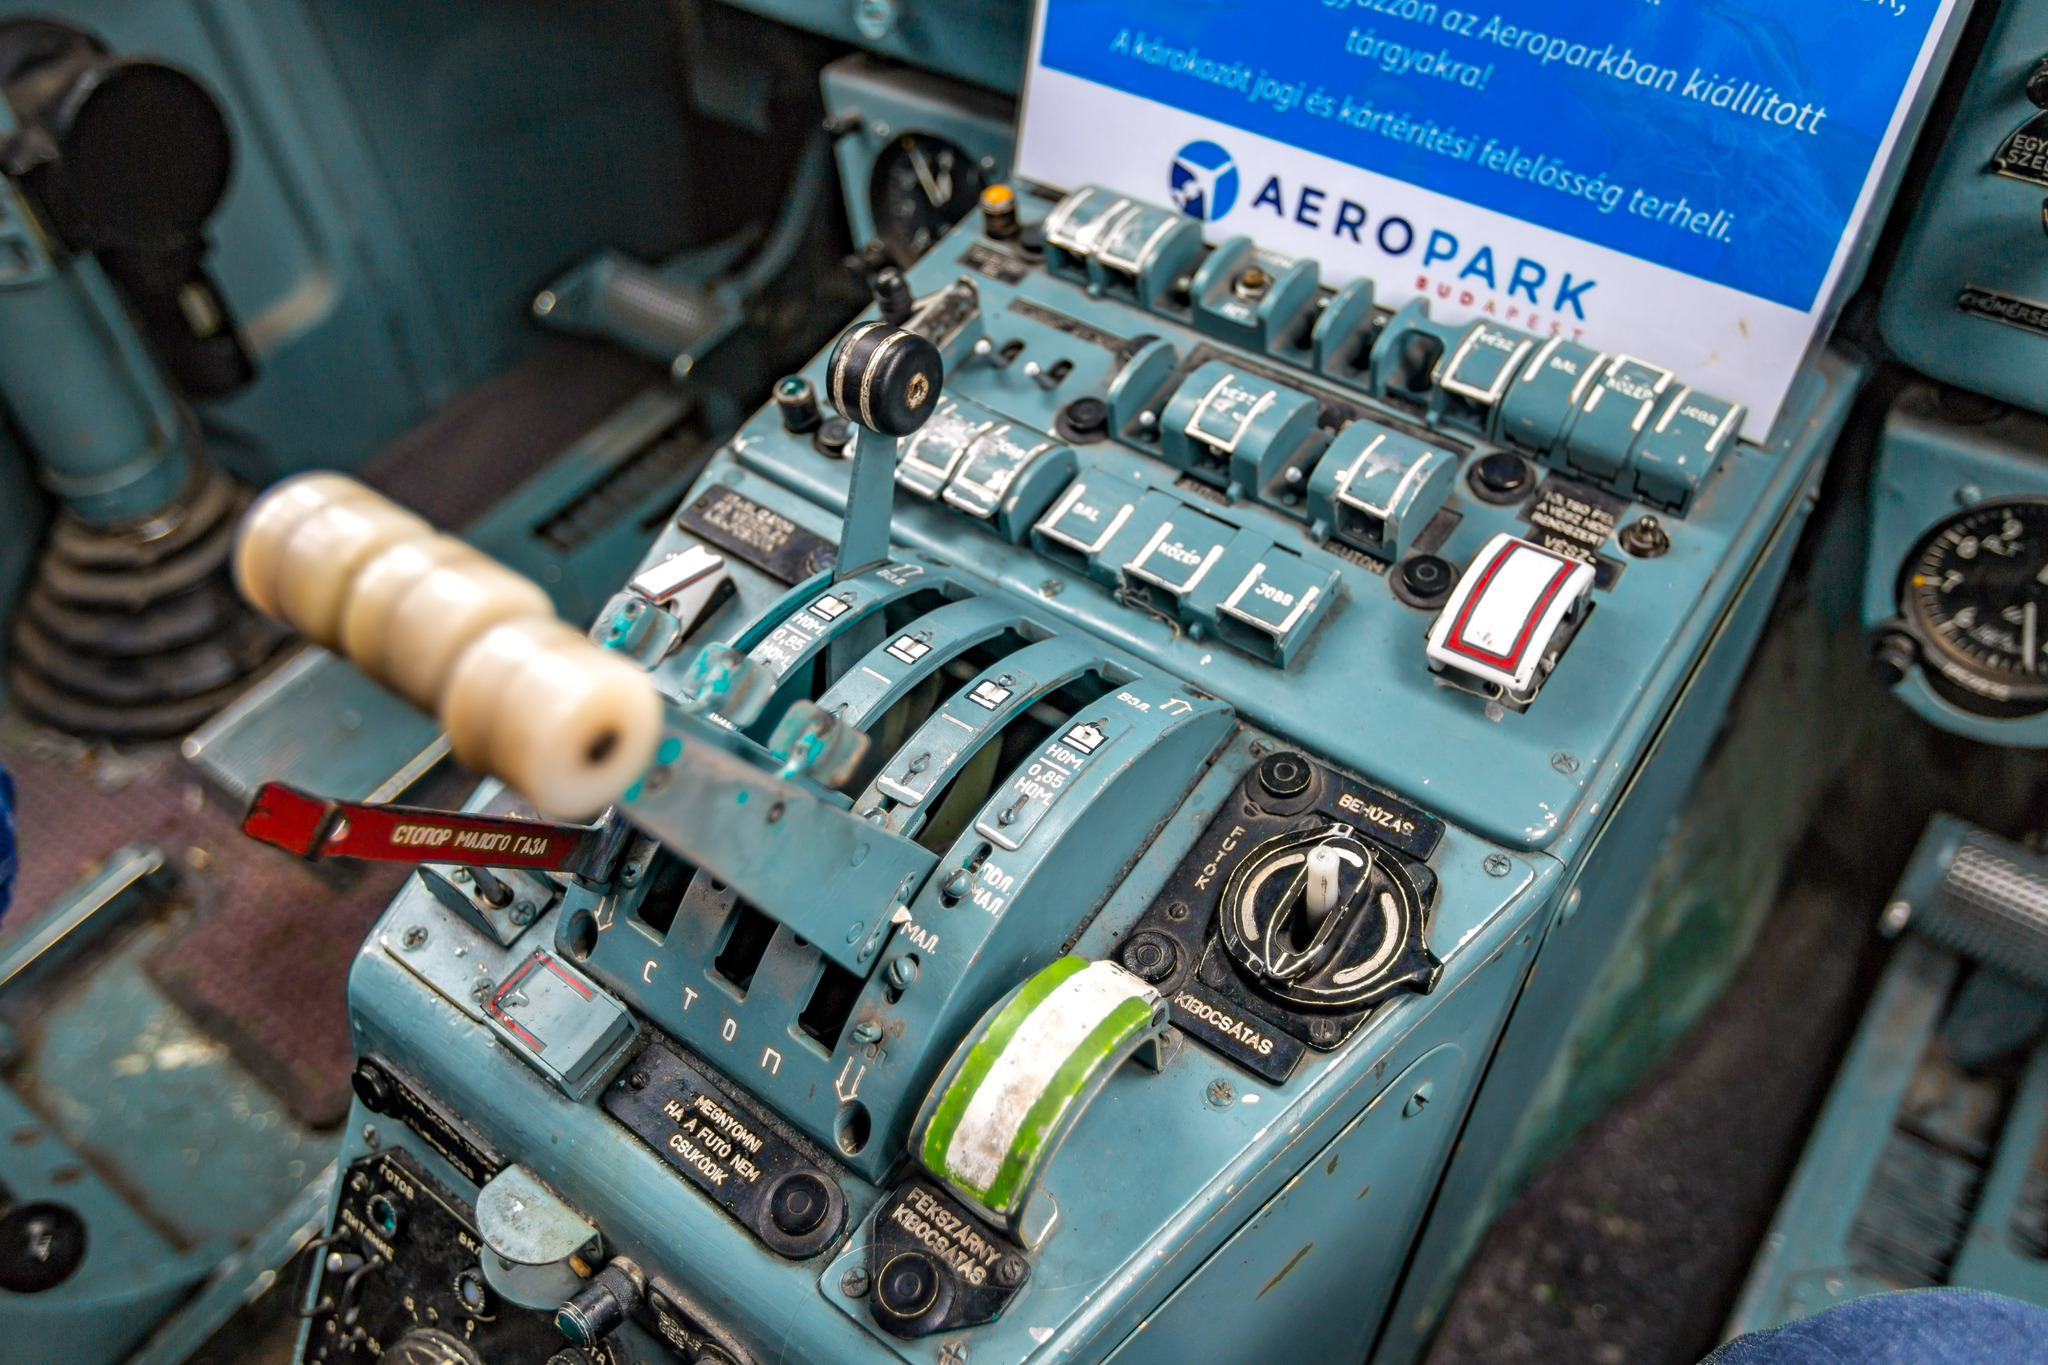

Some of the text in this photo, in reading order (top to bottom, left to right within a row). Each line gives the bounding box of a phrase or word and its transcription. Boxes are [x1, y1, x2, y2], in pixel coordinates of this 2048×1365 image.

[1346, 26, 1496, 91] tárgyakra!
[1441, 8, 1481, 37] az
[1477, 14, 1678, 93] Aeroparkban
[1682, 68, 1828, 135] kiállított
[1109, 28, 1735, 243] A károkozót jogi és kártérítési felelősség terheli.
[2012, 134, 2048, 156] EGY
[1252, 175, 1597, 321] AEROPARK
[1416, 275, 1583, 340] BUDAPEST
[1550, 356, 1577, 376] BAL
[1072, 502, 1099, 522] BAL
[1158, 542, 1202, 567] KÖZÉP
[1254, 582, 1294, 607] JOBB
[771, 629, 807, 651] 0,85
[1117, 692, 1151, 713] ВЗЛ.
[1045, 743, 1083, 771] НОМ.
[1013, 776, 1054, 806] НОМ.
[1028, 763, 1066, 789] 0,85
[393, 825, 548, 856] СТОПОР МАЛОГО ГАЗА
[1194, 826, 1246, 890] FUTÓK
[900, 921, 939, 955] МАЛ.
[694, 1094, 763, 1154] MEGNYOMNI
[663, 1100, 760, 1183] HA A FUTÓ NEM
[669, 1134, 729, 1186] CSUKÓDIK
[378, 1163, 415, 1200] ГОТОВ
[341, 1208, 394, 1262] ПИТАНИЕ
